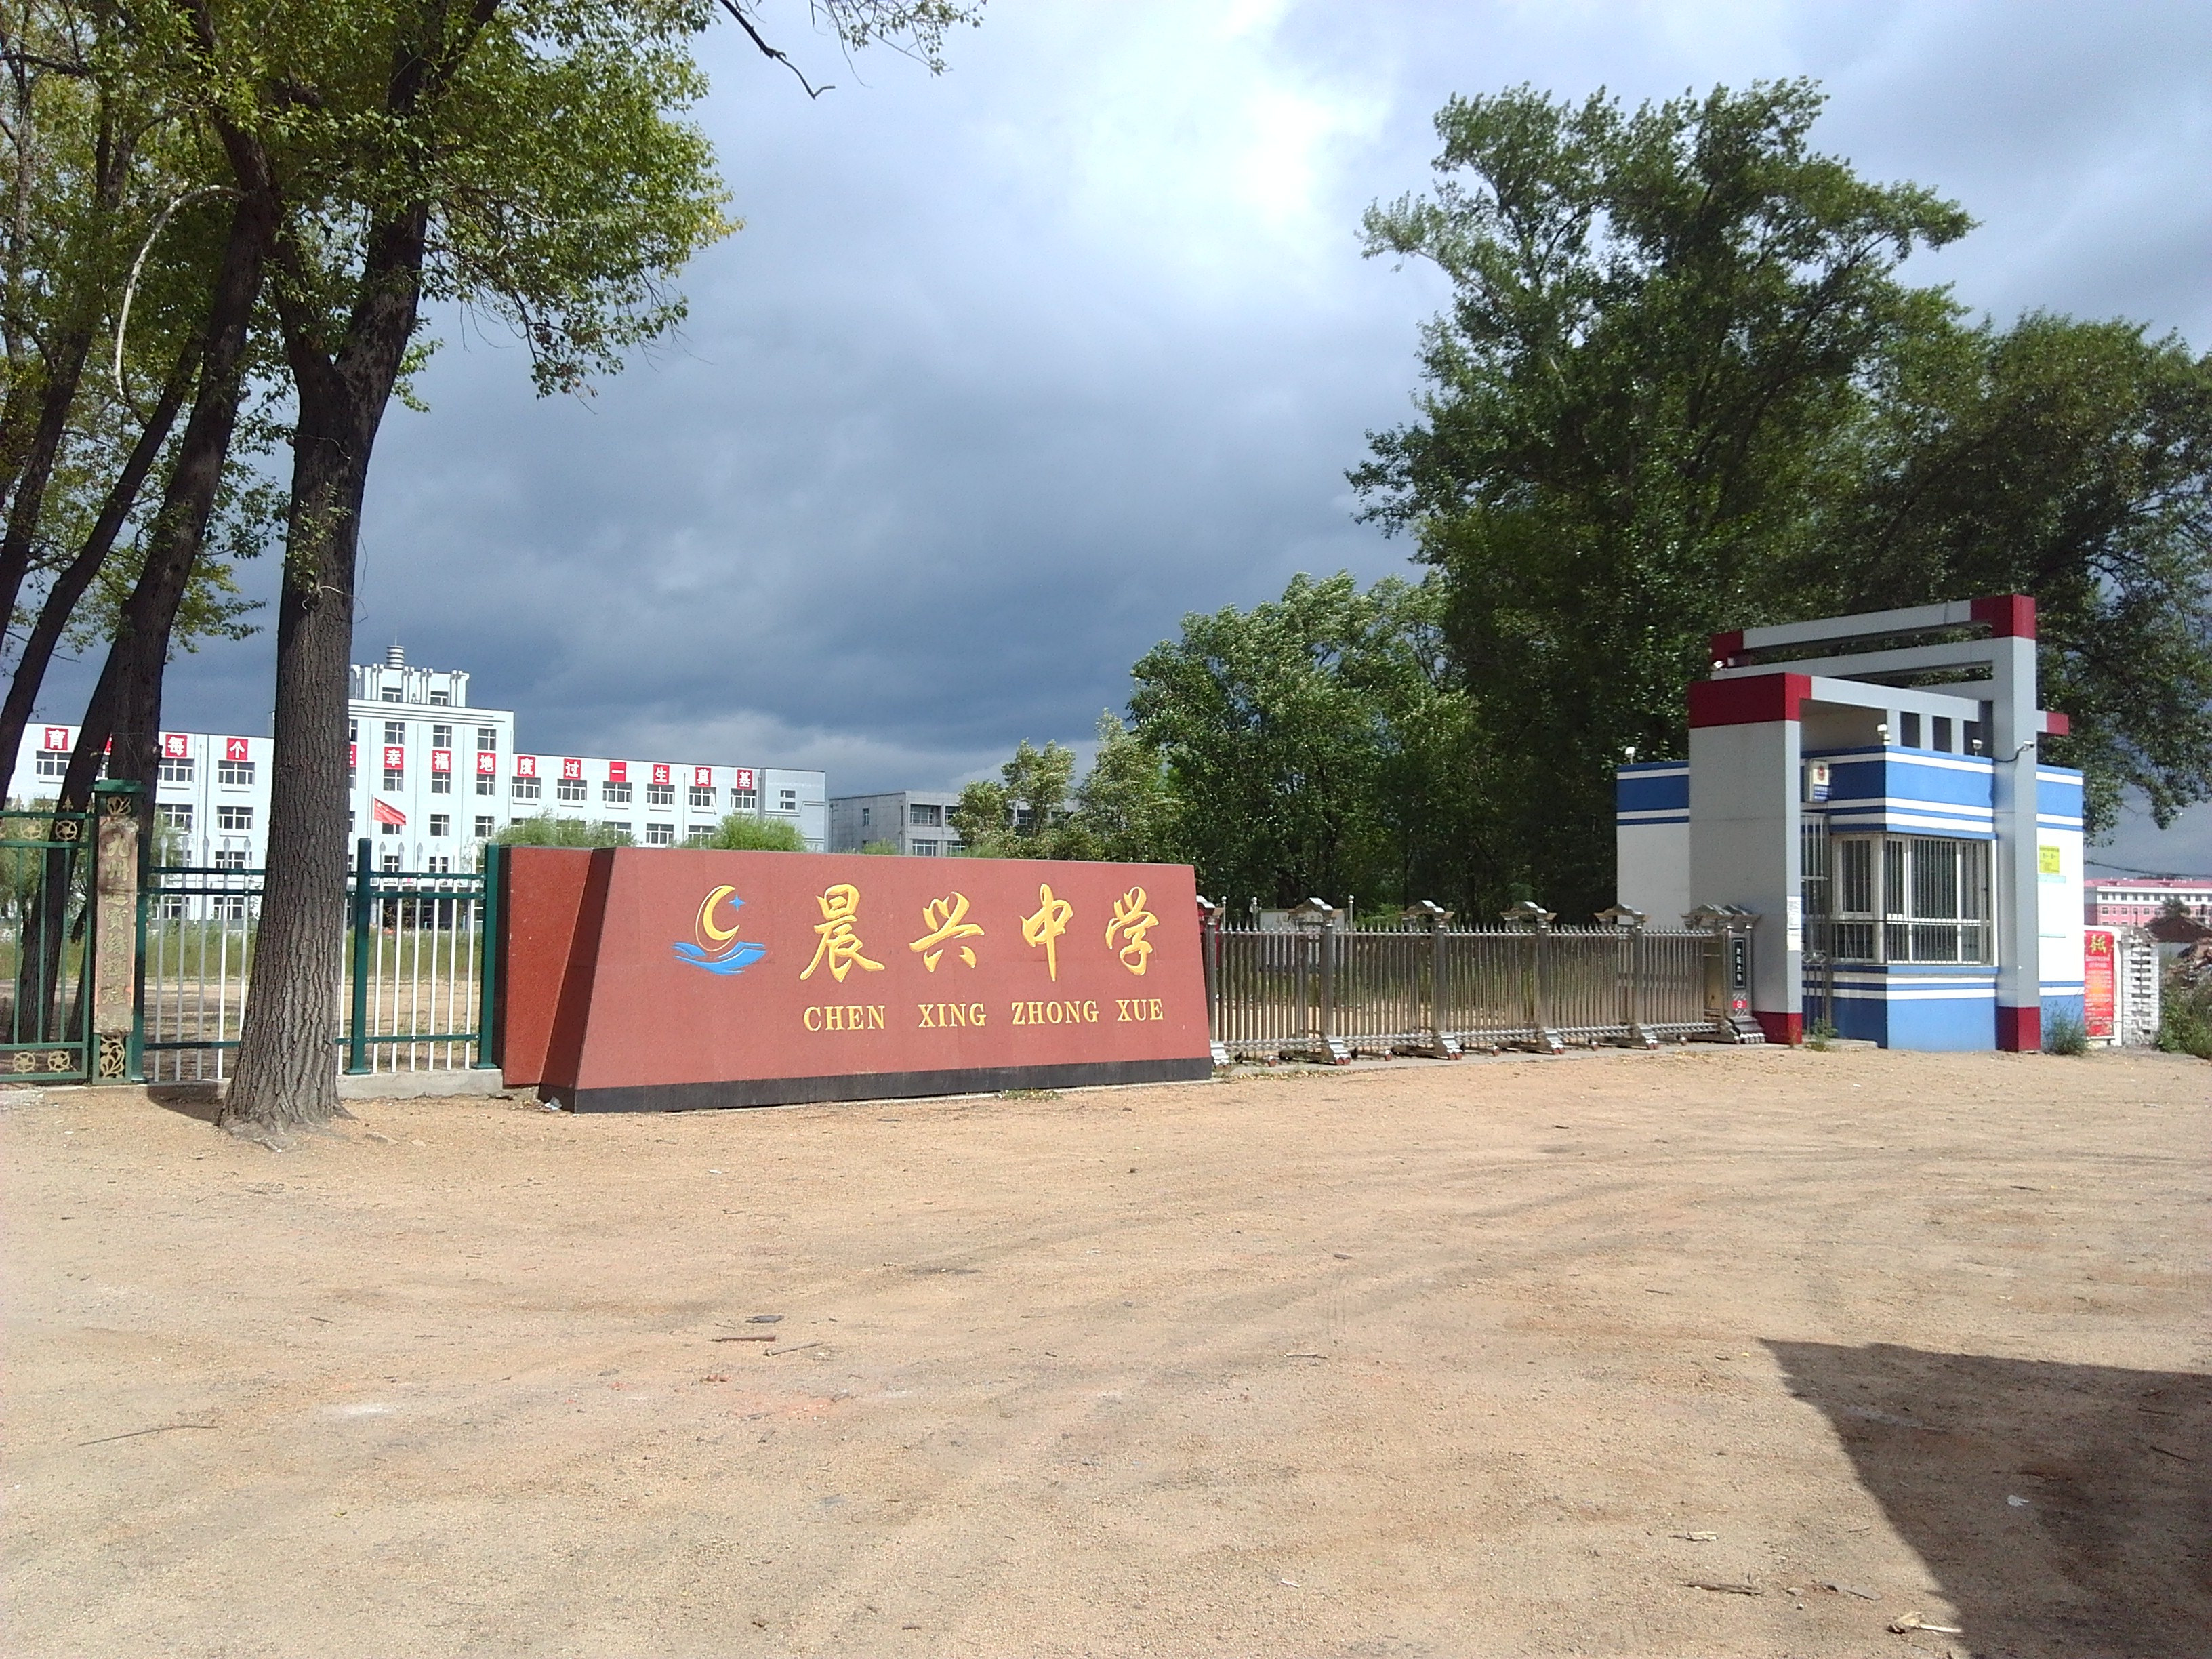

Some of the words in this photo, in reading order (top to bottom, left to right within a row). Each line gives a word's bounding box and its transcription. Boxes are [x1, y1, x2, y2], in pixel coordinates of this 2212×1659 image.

[800, 883, 1160, 983] 晨兴中学
[802, 1004, 886, 1031] CHEN
[917, 1002, 987, 1029] XING
[1011, 1000, 1099, 1025] ZHONG
[1116, 998, 1164, 1022] XUE
